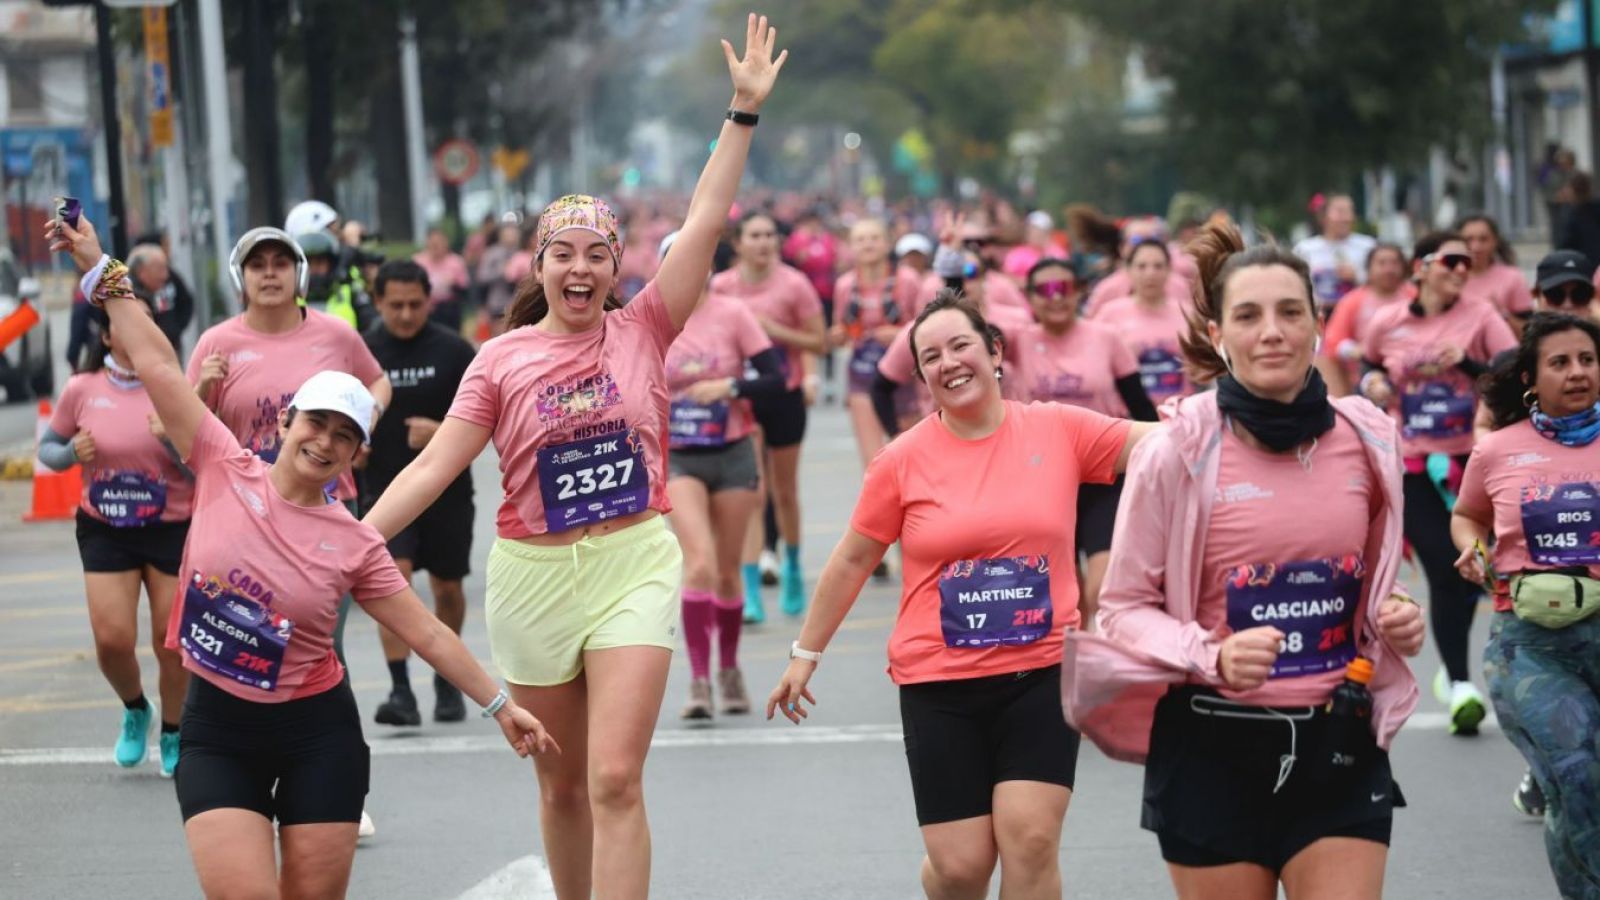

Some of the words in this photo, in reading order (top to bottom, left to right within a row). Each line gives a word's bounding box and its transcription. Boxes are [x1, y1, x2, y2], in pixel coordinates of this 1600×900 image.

[402, 364, 436, 379] TEAM
[573, 418, 627, 439] HISTORIA
[593, 440, 618, 456] 21K
[556, 457, 634, 501] 2327
[1557, 511, 1592, 523] RIOS
[1534, 532, 1578, 547] 1245
[228, 568, 274, 606] CADA
[958, 587, 1034, 604] MARTINEZ
[966, 613, 987, 629] 17
[1012, 608, 1047, 626] 21K
[1250, 597, 1345, 621] CASCIANO
[202, 611, 259, 648] ALEGRIA
[190, 623, 224, 656] 1221
[233, 651, 274, 674] 21K
